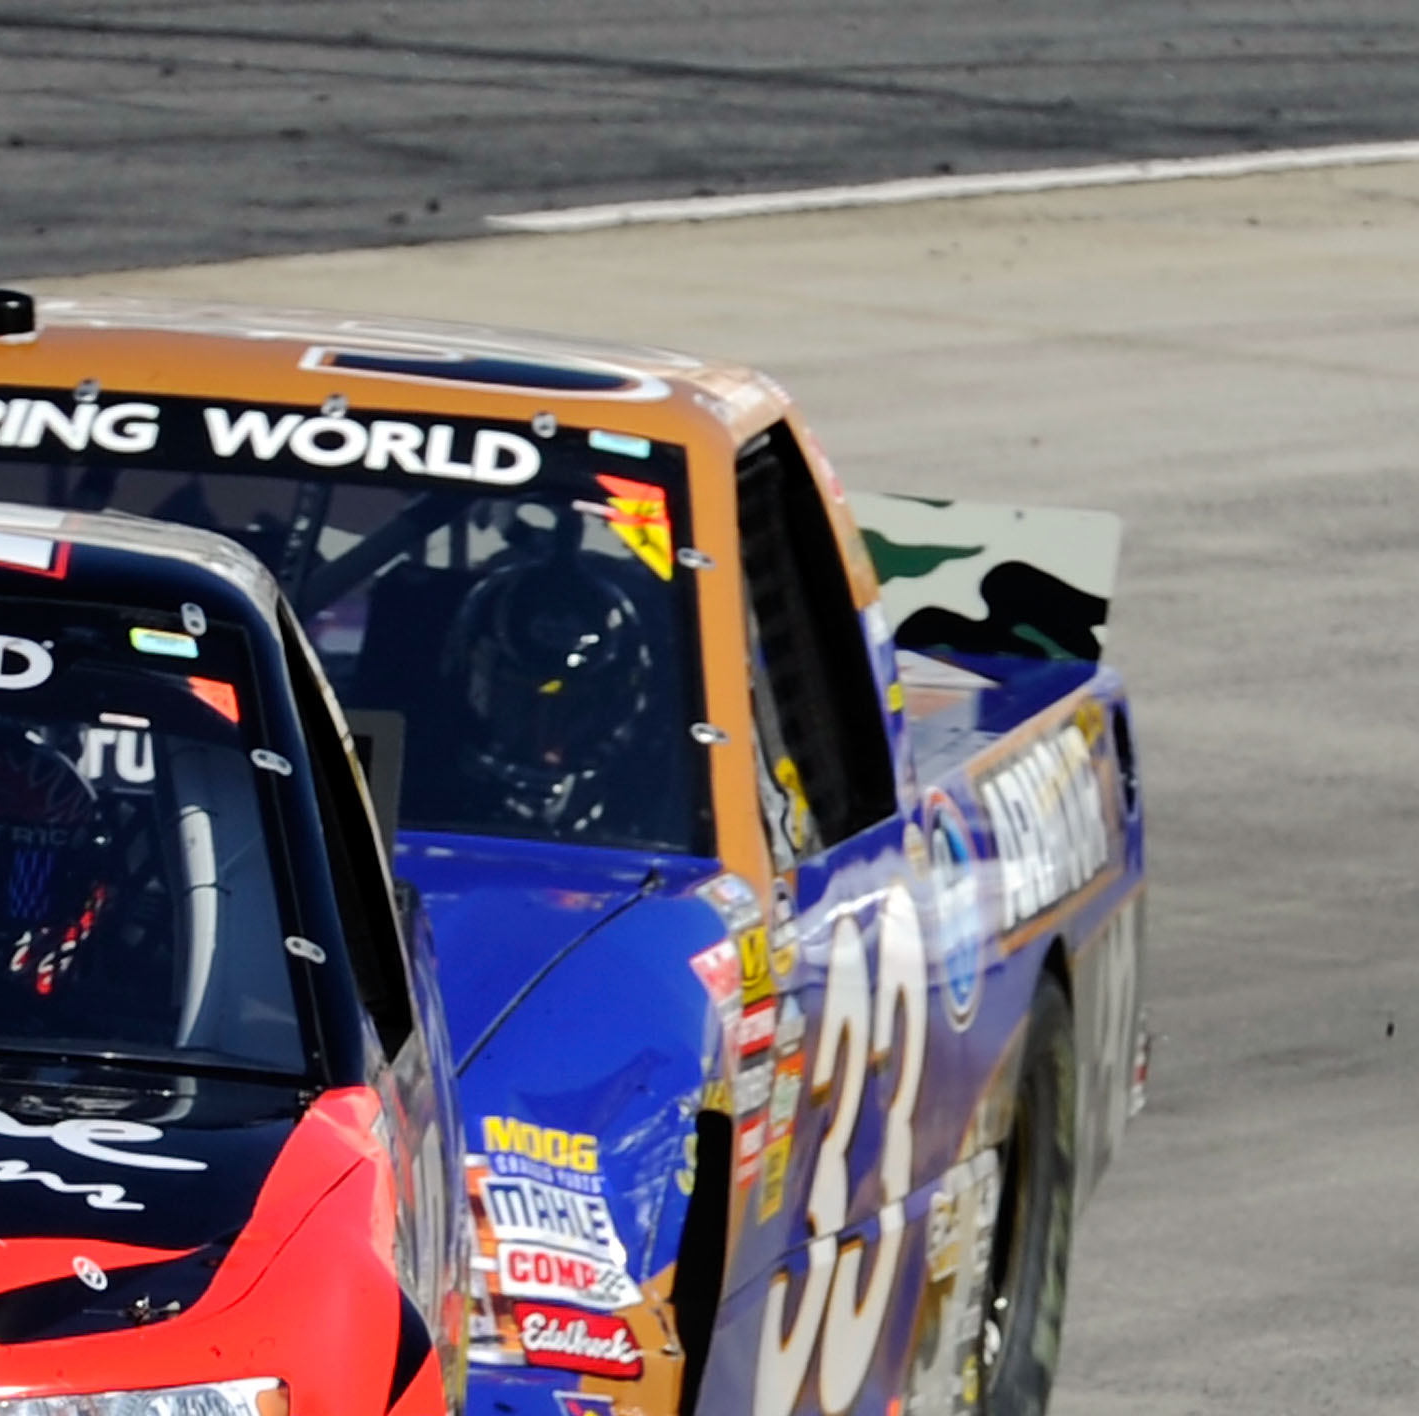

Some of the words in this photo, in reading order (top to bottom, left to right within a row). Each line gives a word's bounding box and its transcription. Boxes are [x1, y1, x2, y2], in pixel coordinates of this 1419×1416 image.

[205, 407, 541, 485] WORLD
[483, 1116, 598, 1173] MOOG
[487, 1183, 610, 1247] MAHLE
